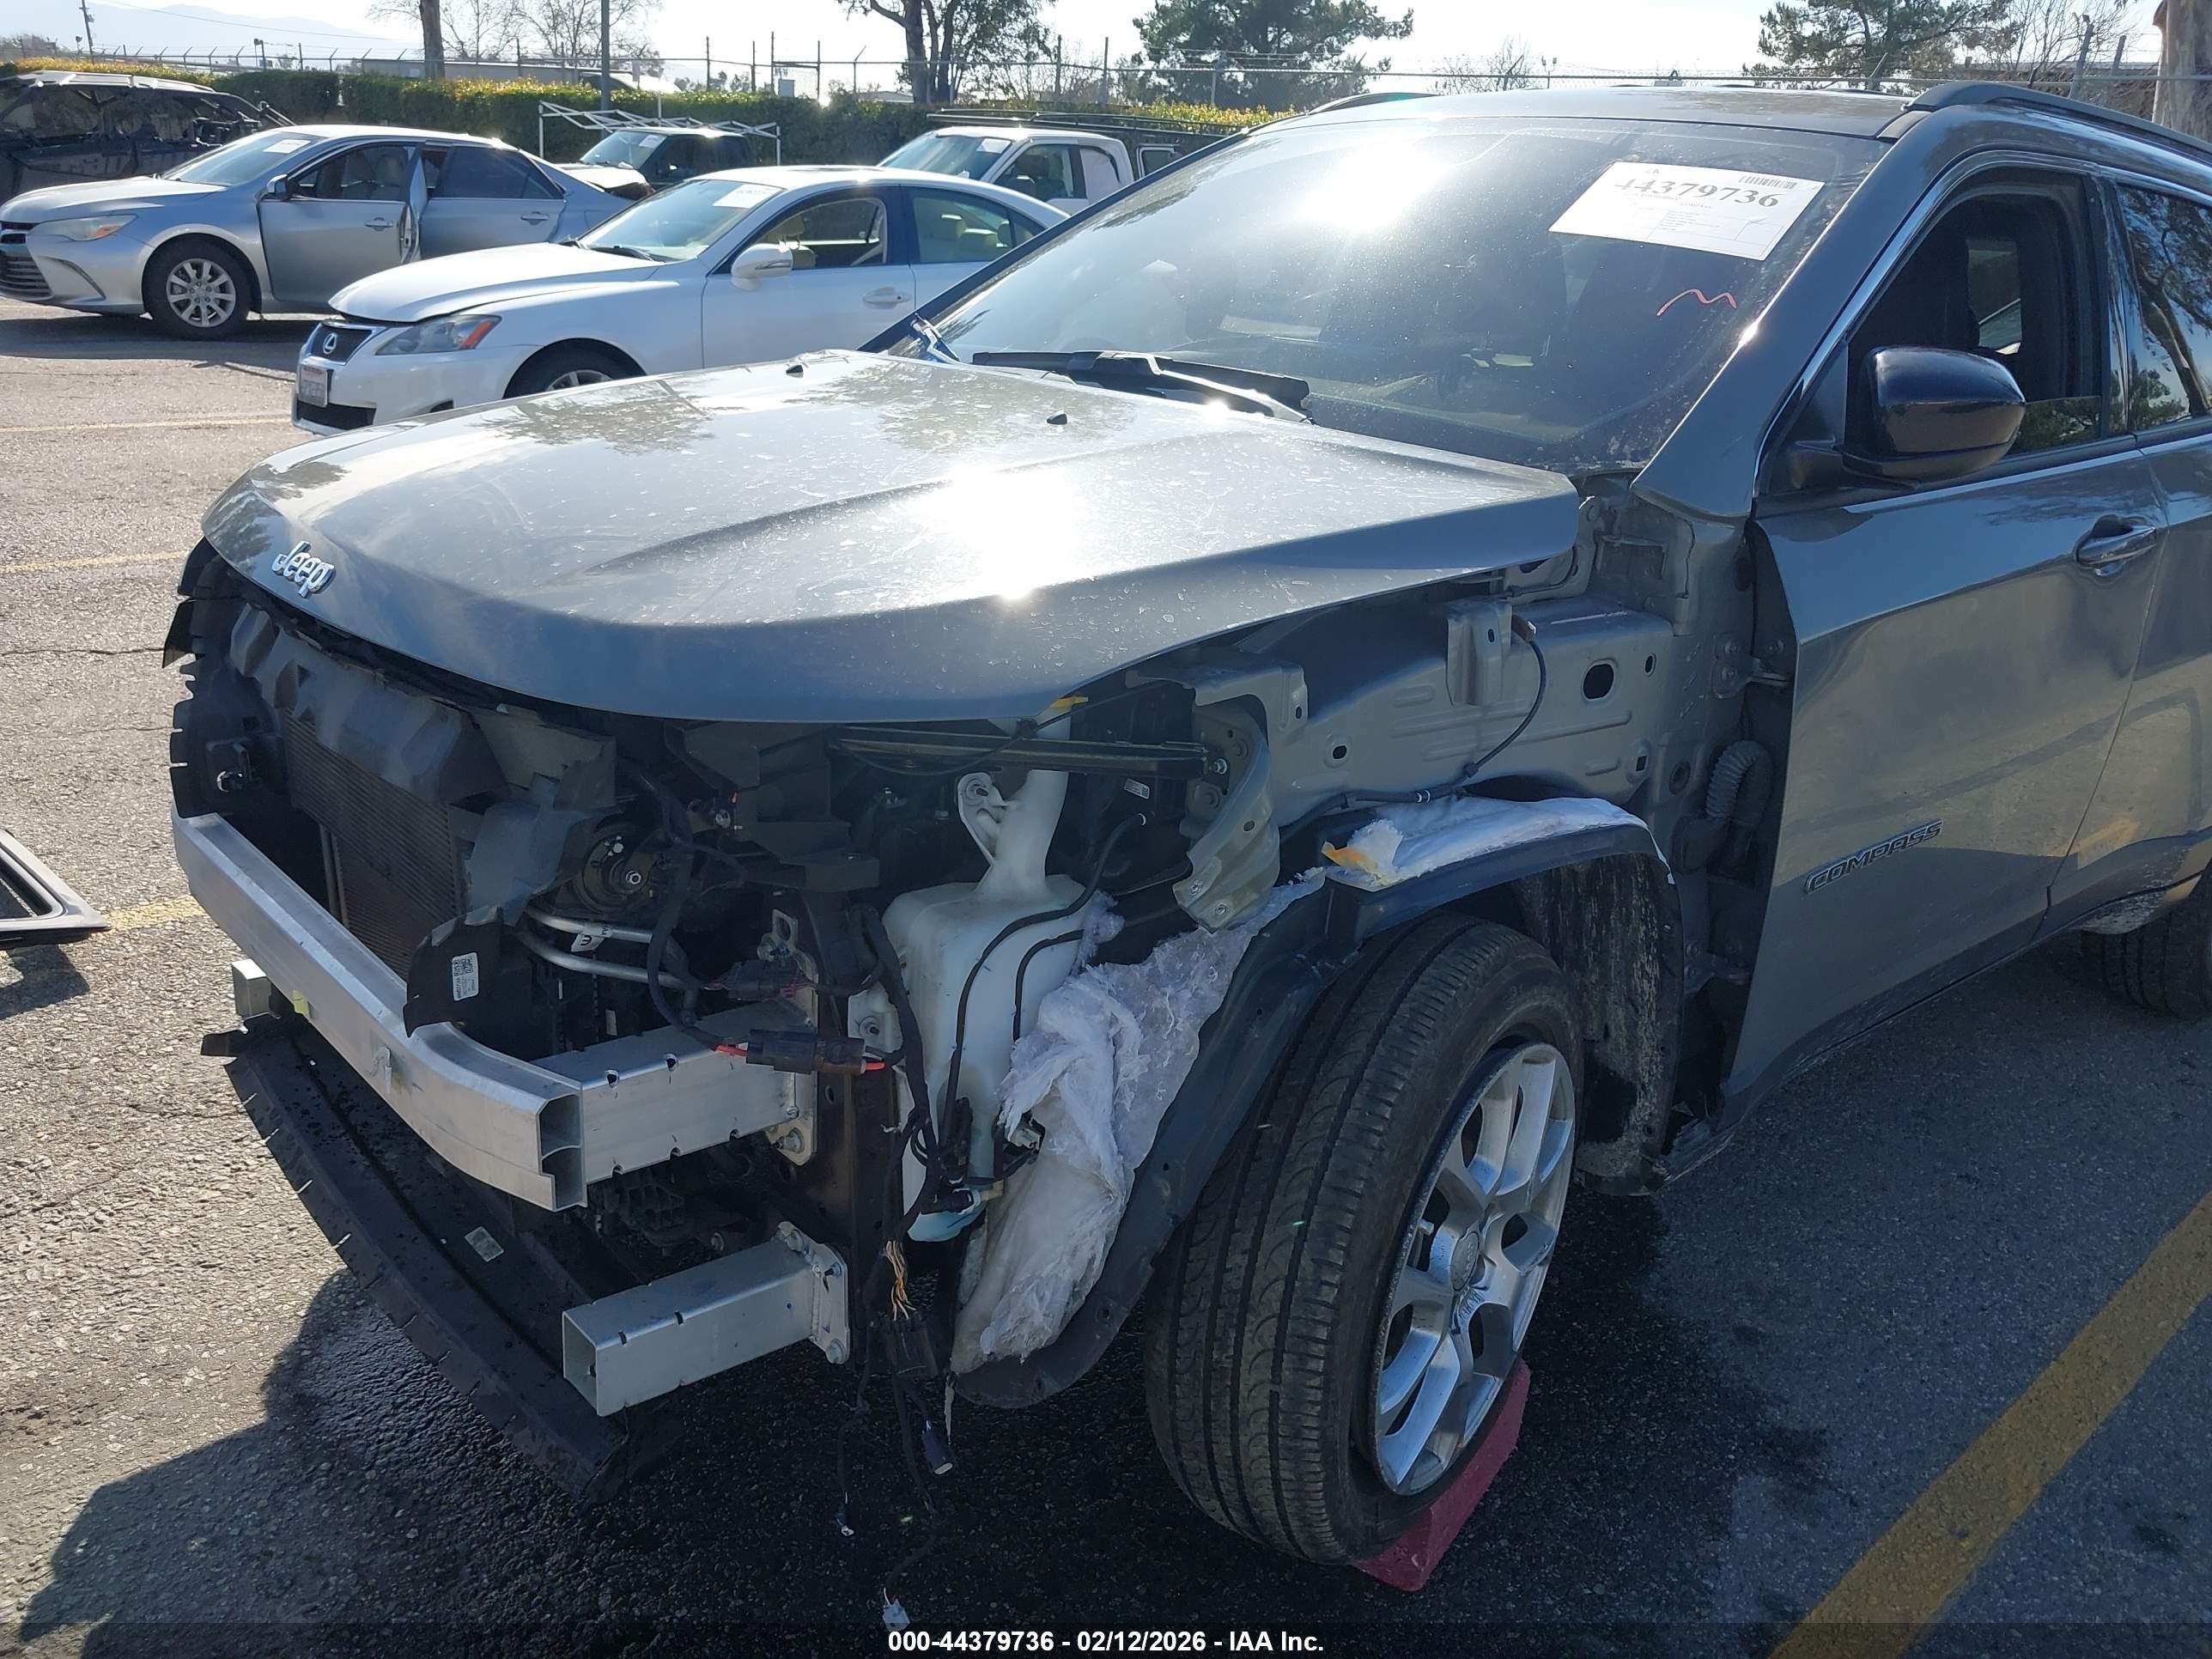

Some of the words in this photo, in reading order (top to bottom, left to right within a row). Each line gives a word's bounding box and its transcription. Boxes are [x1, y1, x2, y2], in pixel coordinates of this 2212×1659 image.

[1613, 177, 1786, 208] 44379736
[271, 540, 336, 599] Jeep
[1804, 819, 1943, 894] COMPASS
